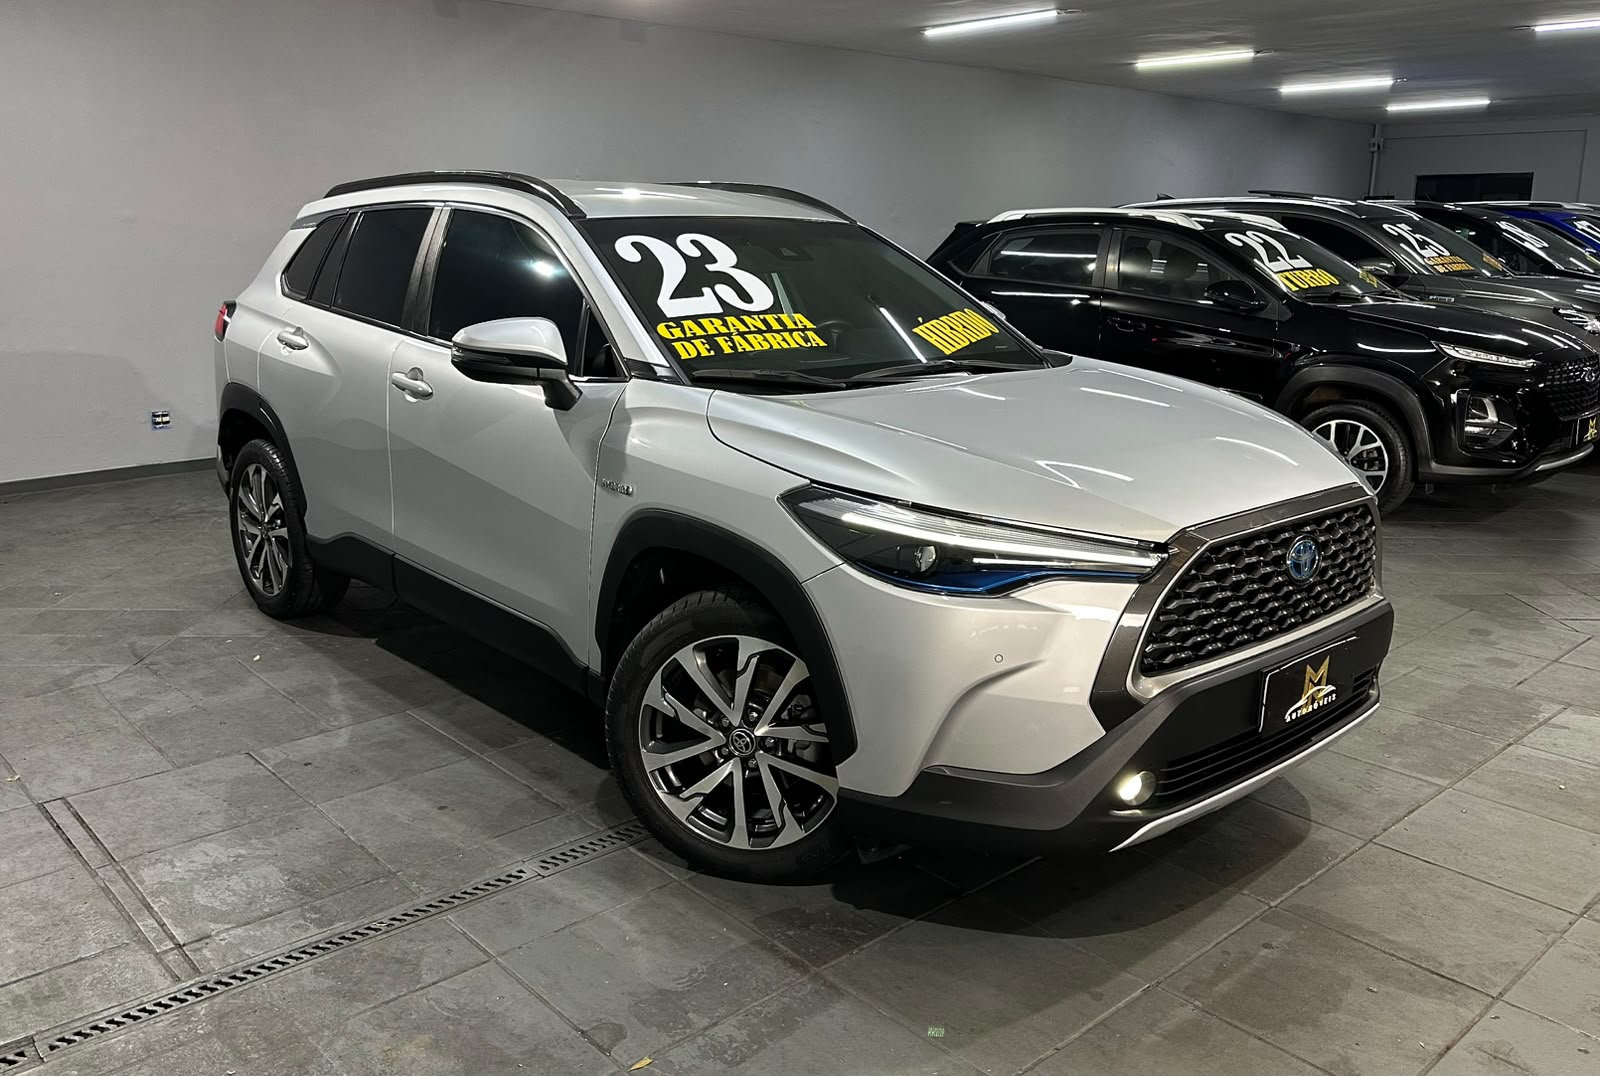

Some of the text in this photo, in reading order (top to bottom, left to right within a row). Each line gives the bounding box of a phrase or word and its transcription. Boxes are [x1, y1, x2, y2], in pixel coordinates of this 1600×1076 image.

[1224, 231, 1313, 272] 22
[1382, 223, 1451, 258] 25
[614, 233, 774, 318] 23
[1276, 268, 1340, 291] TURBO
[656, 312, 816, 340] GARANTIA
[912, 307, 999, 355] HÍBRIDO
[672, 330, 828, 360] DE FÁBRICA
